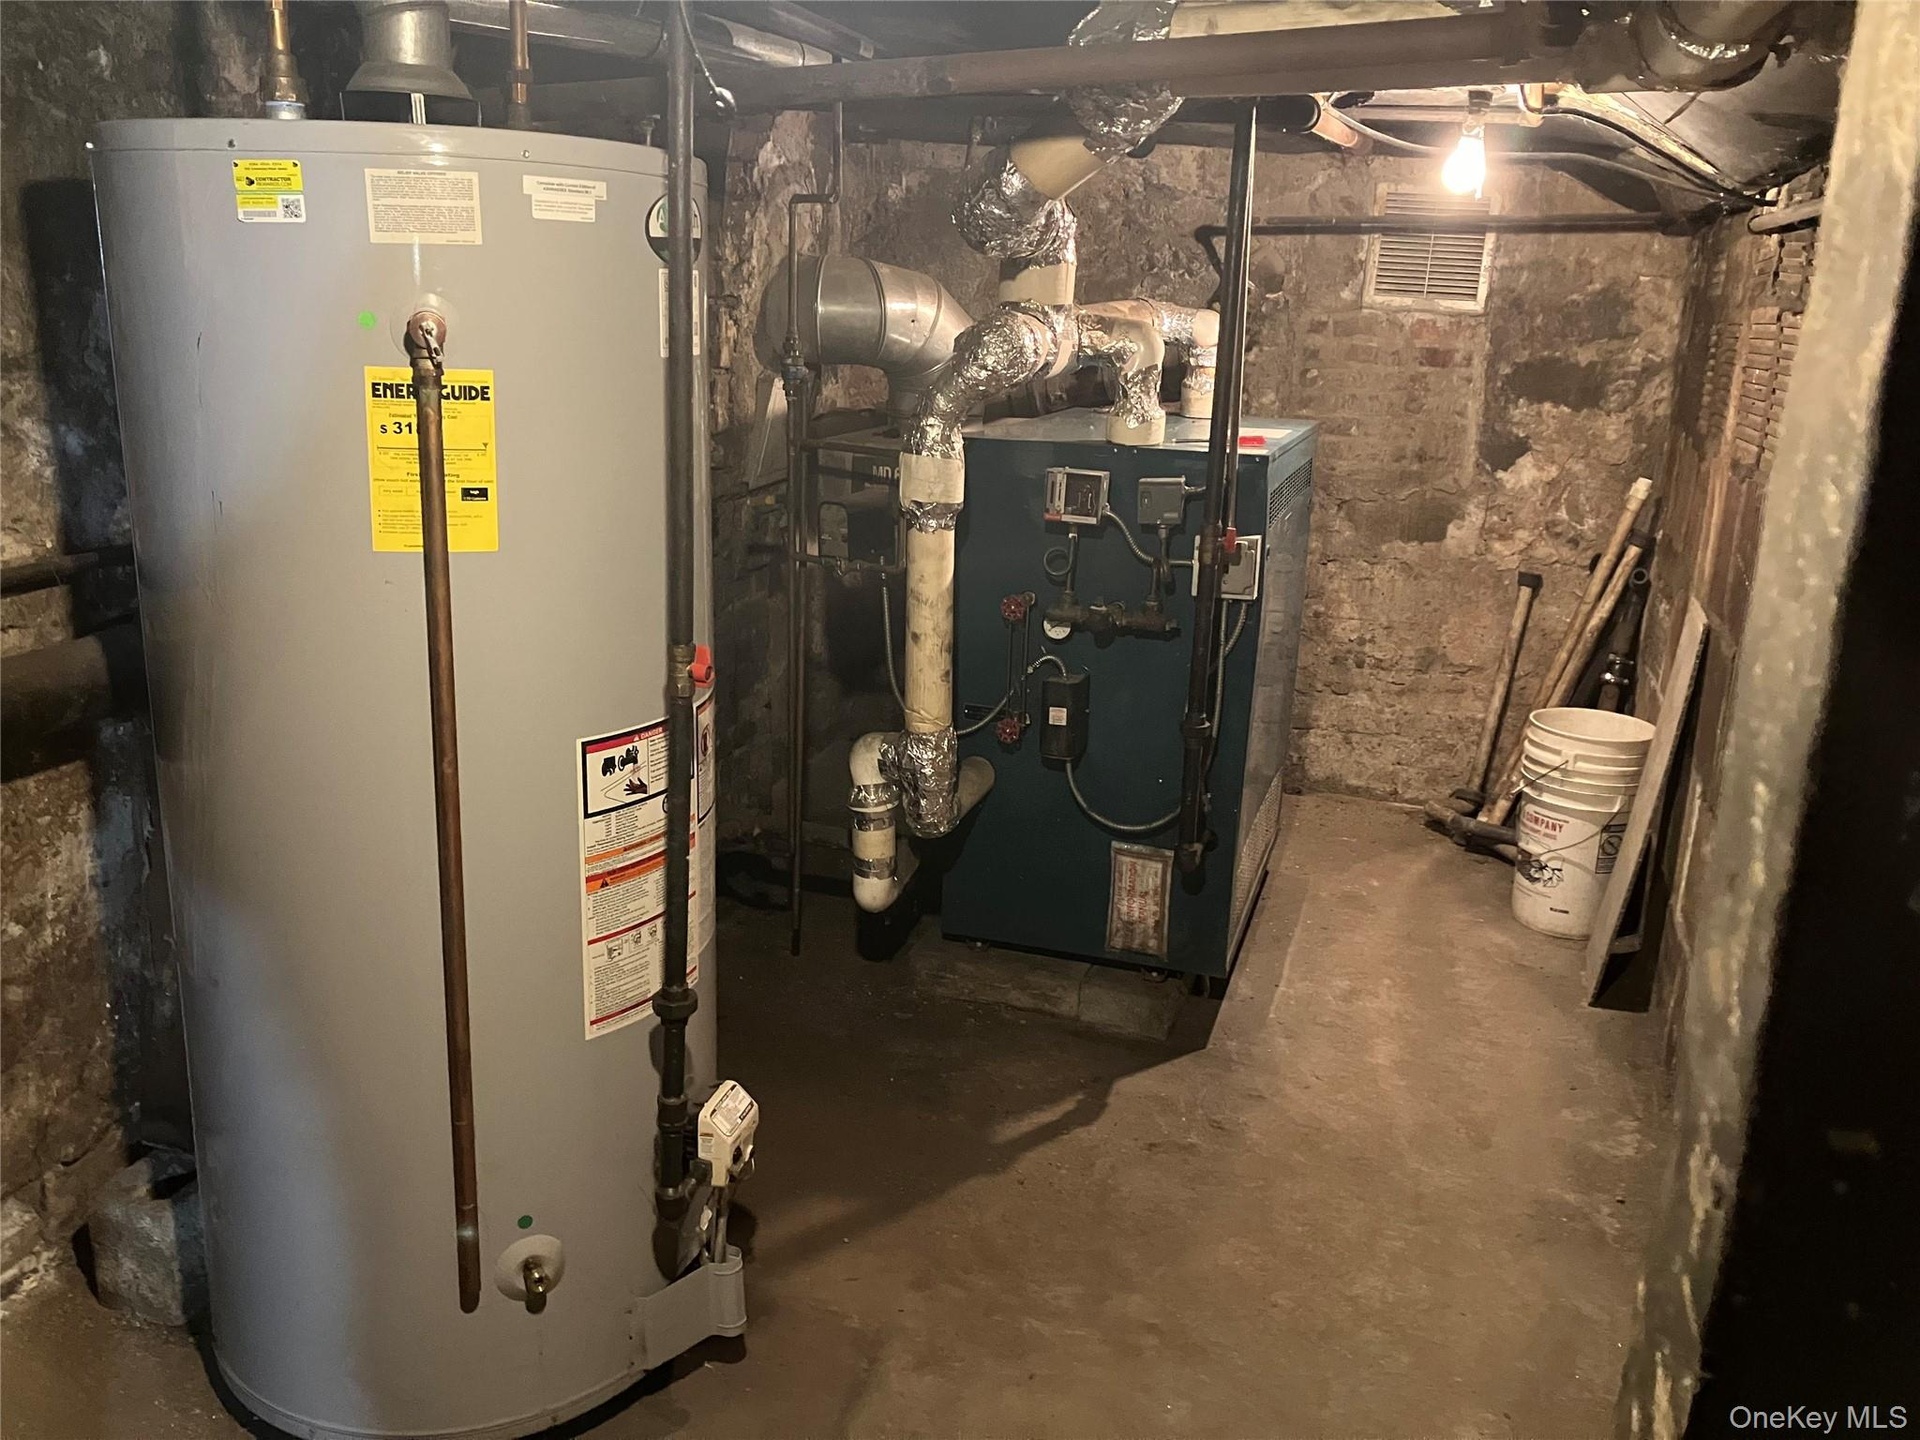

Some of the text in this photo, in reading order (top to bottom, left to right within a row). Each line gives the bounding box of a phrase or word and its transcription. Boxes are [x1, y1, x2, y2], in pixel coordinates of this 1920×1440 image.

[371, 382, 490, 401] ENERGUIDE
[640, 727, 663, 741] DANGER
[1526, 811, 1565, 833] COMPANY
